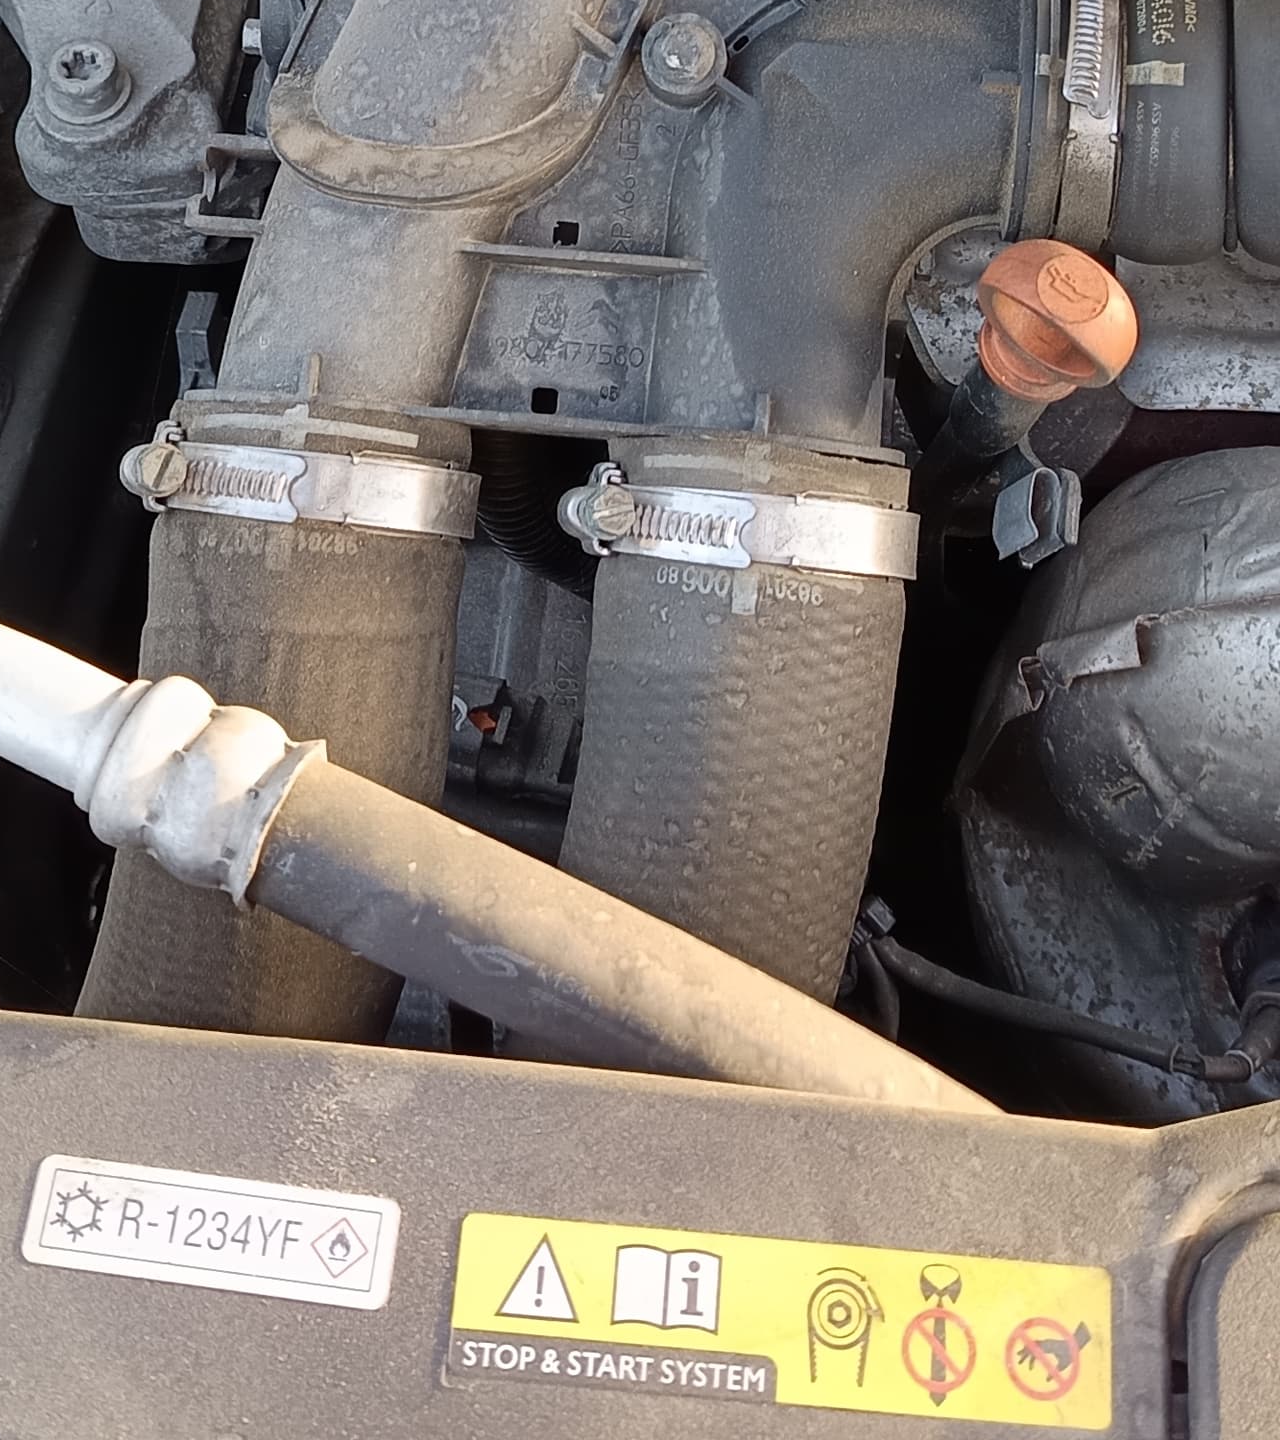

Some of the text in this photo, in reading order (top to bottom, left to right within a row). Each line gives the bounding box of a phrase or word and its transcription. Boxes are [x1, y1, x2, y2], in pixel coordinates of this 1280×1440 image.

[118, 1198, 303, 1259] R-1234YF
[463, 1341, 766, 1392] STOP & START SYSTEM
